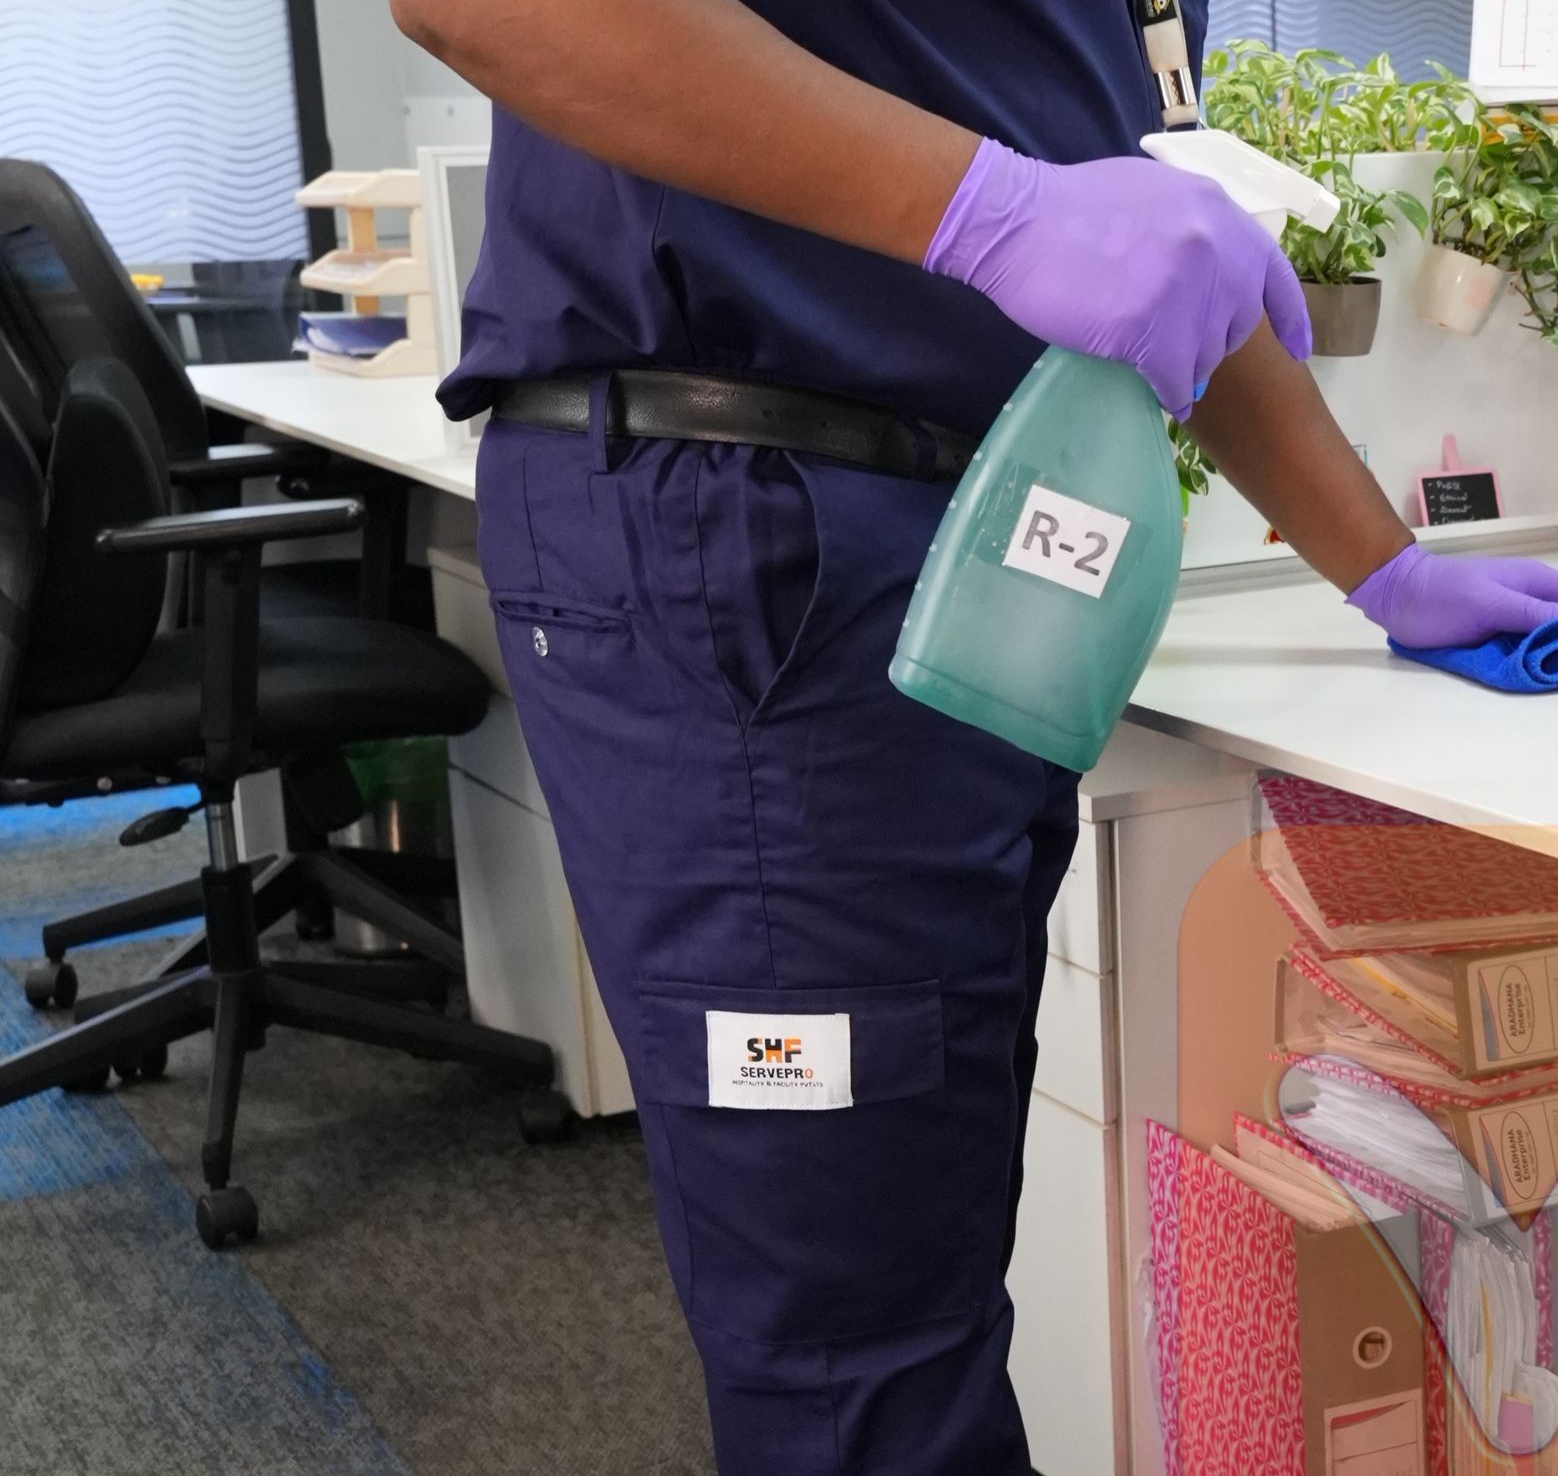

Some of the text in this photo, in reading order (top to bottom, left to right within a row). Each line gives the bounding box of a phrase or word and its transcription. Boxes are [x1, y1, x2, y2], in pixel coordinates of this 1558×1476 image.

[1021, 509, 1108, 576] R-2
[1505, 982, 1518, 1037] ARADHANA
[1514, 983, 1526, 1035] Enterprise
[740, 1066, 813, 1079] SERVEPRO
[747, 1037, 802, 1063] SHF
[1507, 1128, 1523, 1183] ARADHANA
[1516, 1129, 1531, 1181] Enterprise
